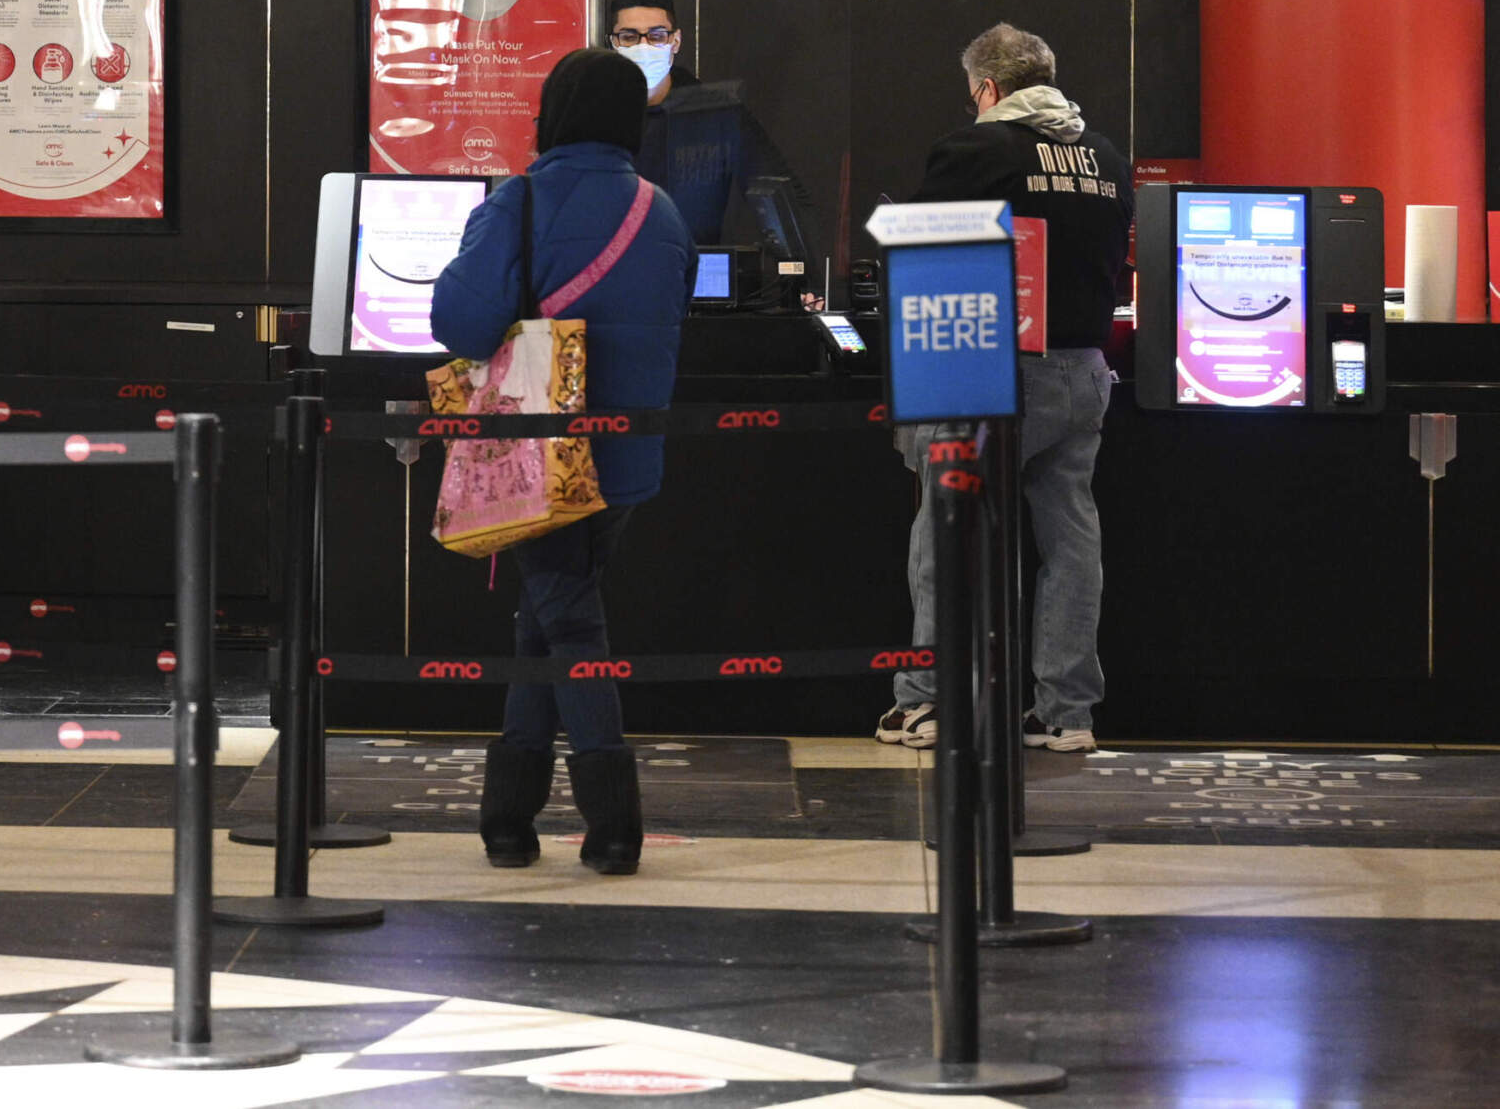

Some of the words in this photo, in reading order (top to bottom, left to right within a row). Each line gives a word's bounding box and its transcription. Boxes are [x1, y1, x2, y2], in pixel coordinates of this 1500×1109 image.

[476, 40, 496, 50] Put
[497, 41, 523, 51] Your
[441, 54, 470, 64] Mask
[473, 54, 490, 64] On
[493, 54, 521, 64] Now.
[465, 138, 493, 147] amc
[1036, 142, 1100, 178] MOVIES
[448, 165, 470, 174] Safe
[472, 165, 481, 174] &
[481, 165, 510, 175] Clean
[1147, 166, 1166, 174] Policies
[1027, 175, 1049, 192] NOW
[1051, 175, 1076, 193] MORE
[1078, 177, 1099, 195] THAN
[1099, 180, 1117, 199] EVER
[901, 293, 999, 320] ENTER
[902, 317, 999, 353] HERE
[118, 385, 167, 398] amc
[418, 417, 481, 436] amc
[567, 415, 631, 434] amc
[717, 409, 780, 429] amc
[719, 657, 783, 676] amc
[870, 650, 935, 669] amc
[419, 661, 483, 679] amc
[569, 660, 633, 678] amc
[1170, 759, 1331, 770] BUY
[1082, 767, 1422, 780] TICKETS
[1151, 776, 1363, 788] HERE
[1168, 802, 1364, 811] DEBIT
[1143, 816, 1398, 828] CREDIT
